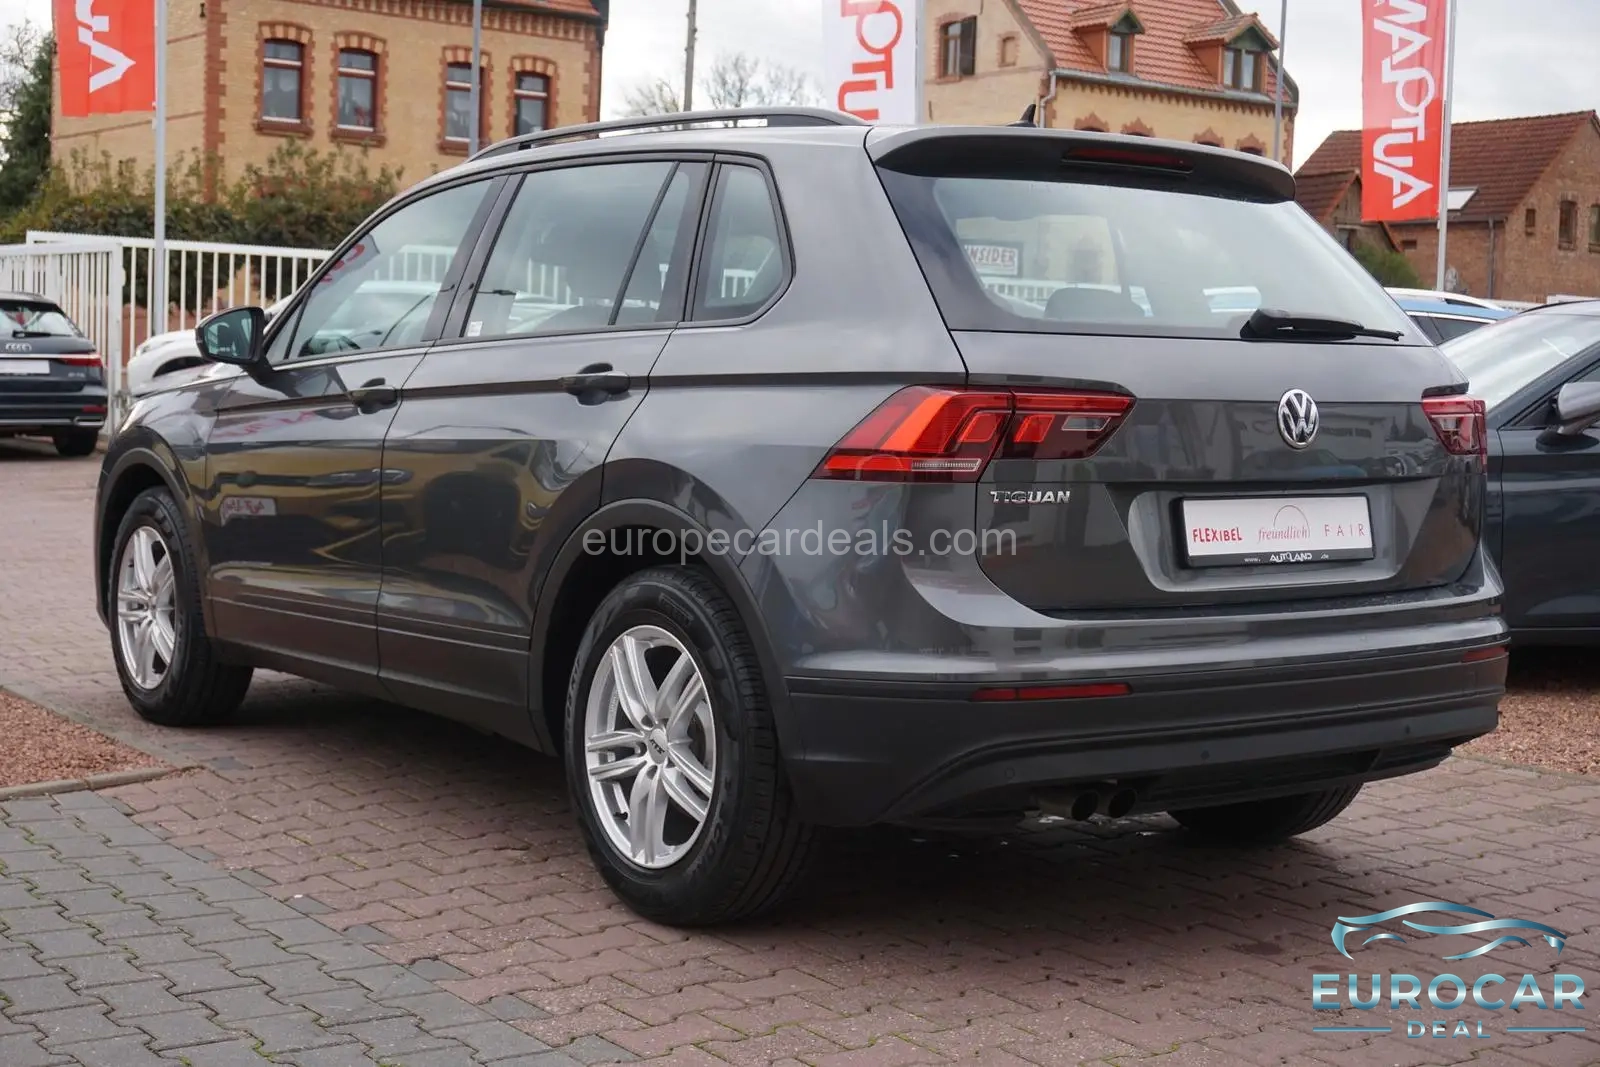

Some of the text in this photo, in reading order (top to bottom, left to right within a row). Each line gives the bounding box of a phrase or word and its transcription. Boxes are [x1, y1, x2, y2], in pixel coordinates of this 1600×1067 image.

[990, 490, 1071, 504] TIGUAN
[1192, 527, 1243, 543] FLEXIBEL
[1257, 525, 1308, 544] freundlich
[1269, 551, 1313, 563] AUTOLAND
